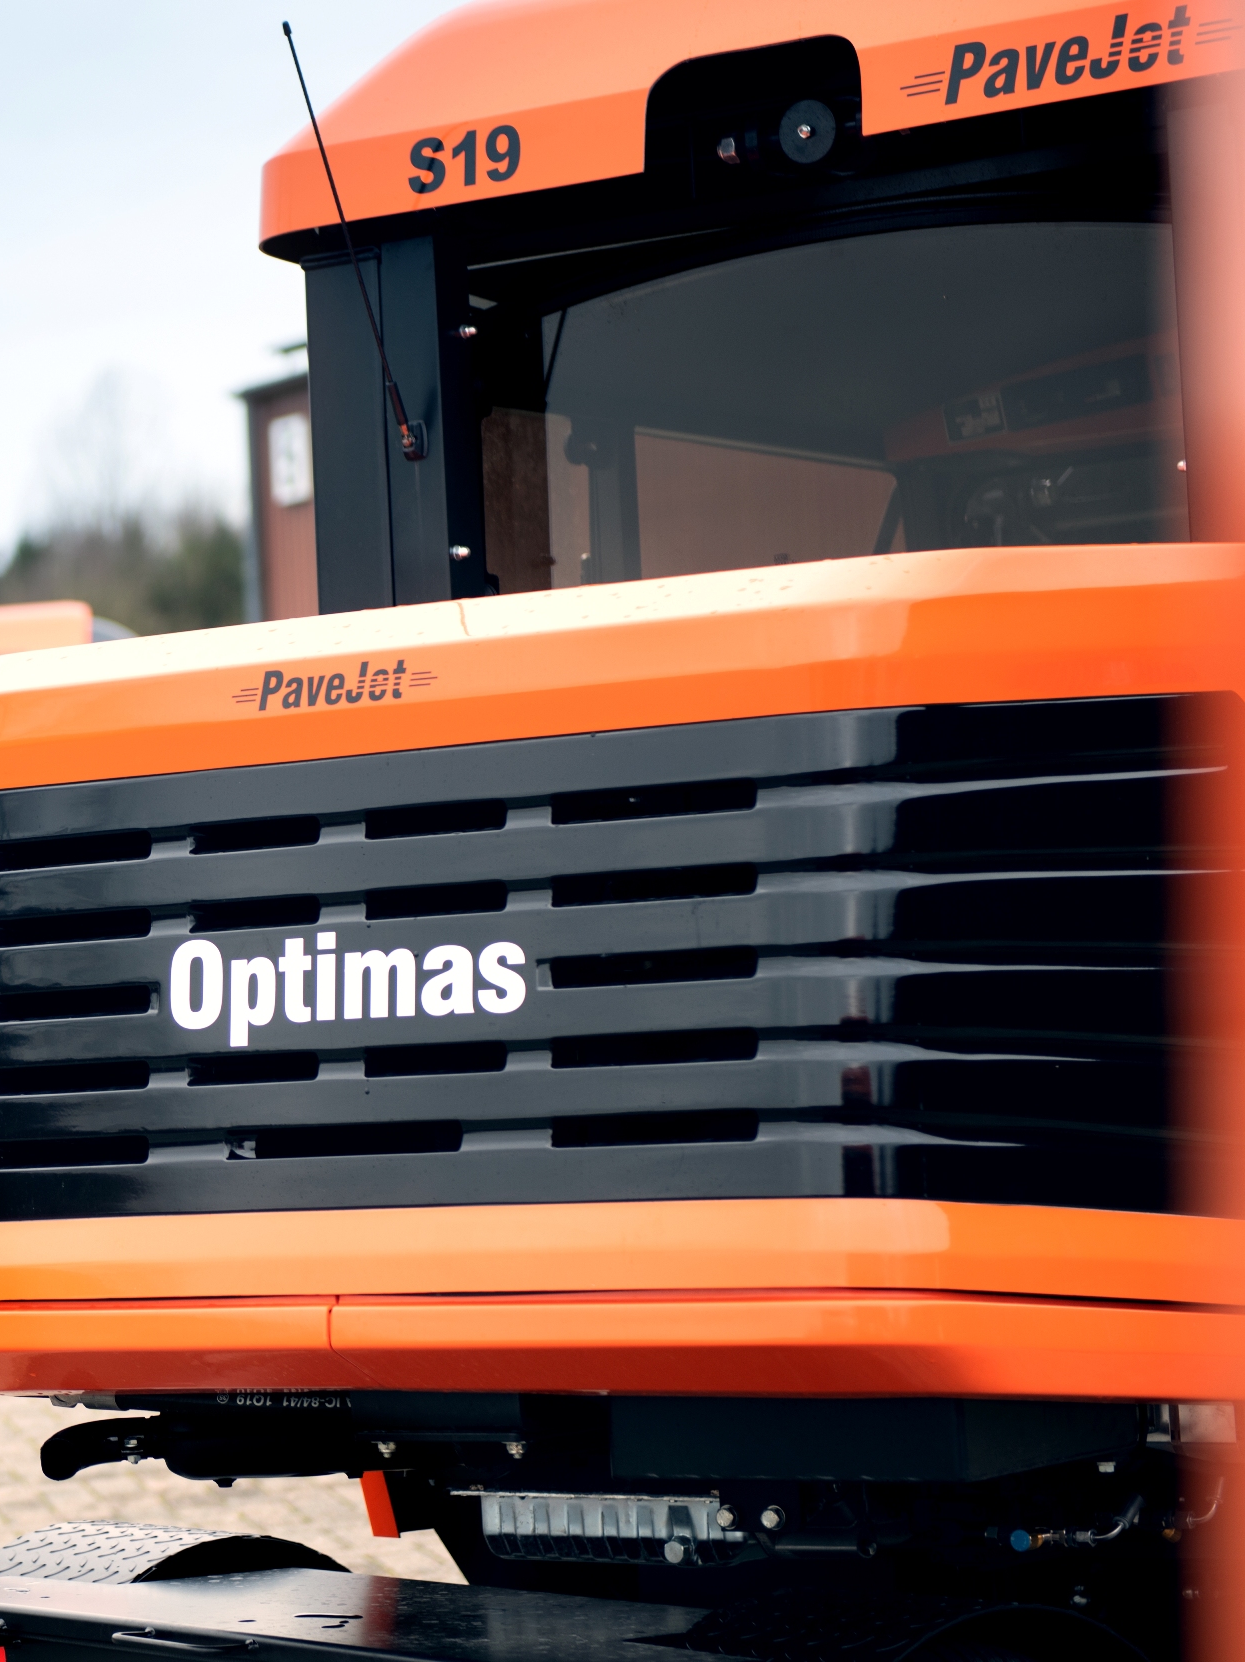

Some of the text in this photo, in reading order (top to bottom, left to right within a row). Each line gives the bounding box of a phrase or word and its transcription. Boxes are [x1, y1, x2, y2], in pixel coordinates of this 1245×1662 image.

[944, 4, 1192, 106] PaveJet
[408, 124, 521, 194] S19
[258, 659, 407, 711] PaveJet
[170, 931, 527, 1047] Optimas
[236, 1393, 273, 1407] 1Q19
